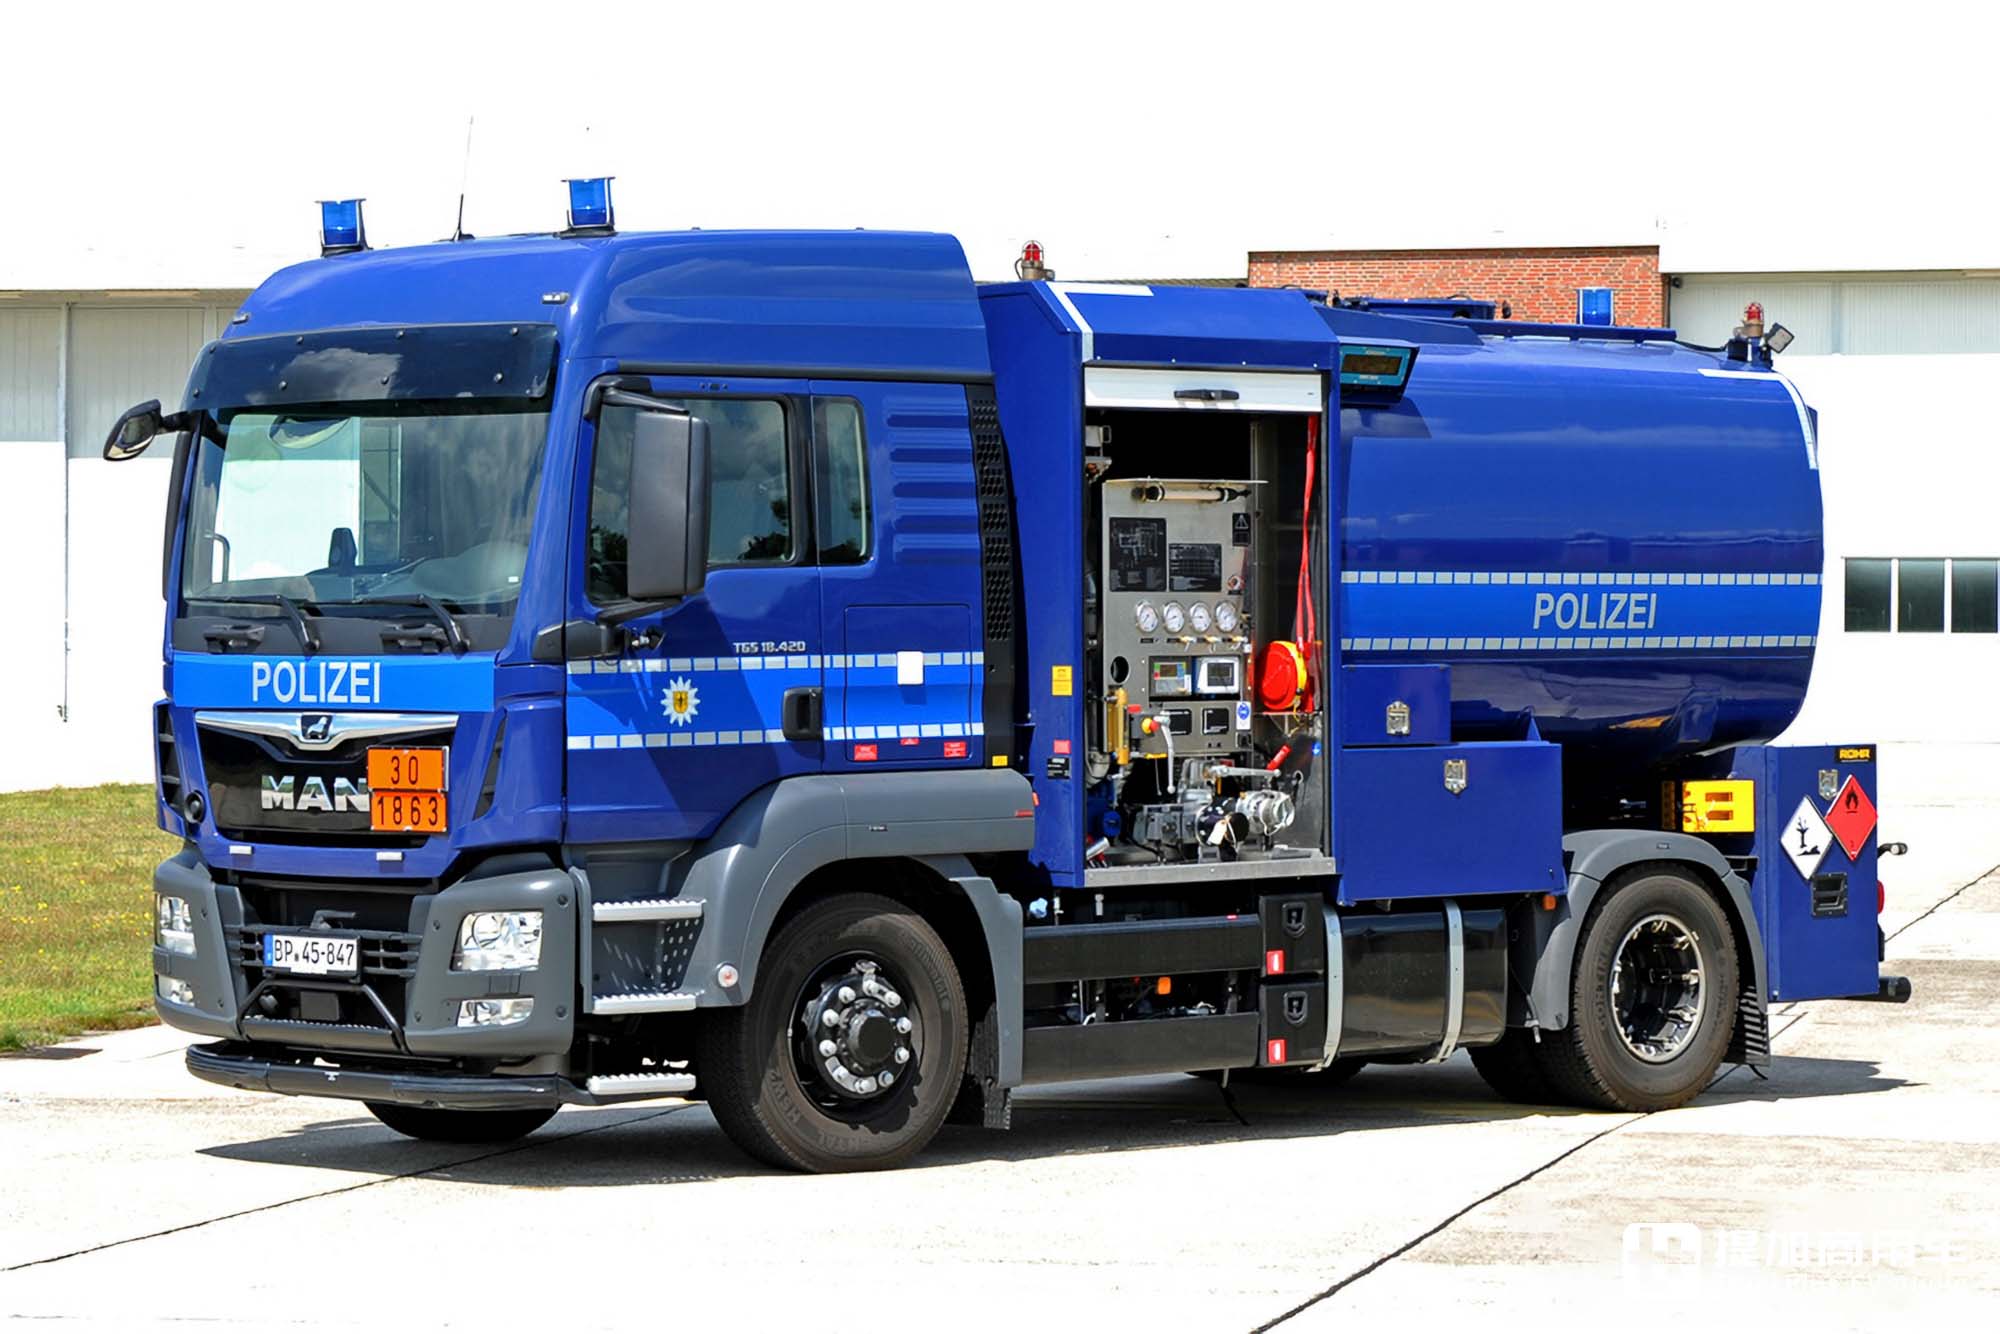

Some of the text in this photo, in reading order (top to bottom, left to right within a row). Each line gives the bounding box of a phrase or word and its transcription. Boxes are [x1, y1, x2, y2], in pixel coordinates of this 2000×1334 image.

[1532, 592, 1657, 630] POLIZEI
[732, 640, 806, 654] TGS 18.420
[252, 661, 380, 703] POLIZEI
[391, 756, 419, 785] 30
[261, 775, 370, 812] MAN
[377, 796, 438, 826] 1863
